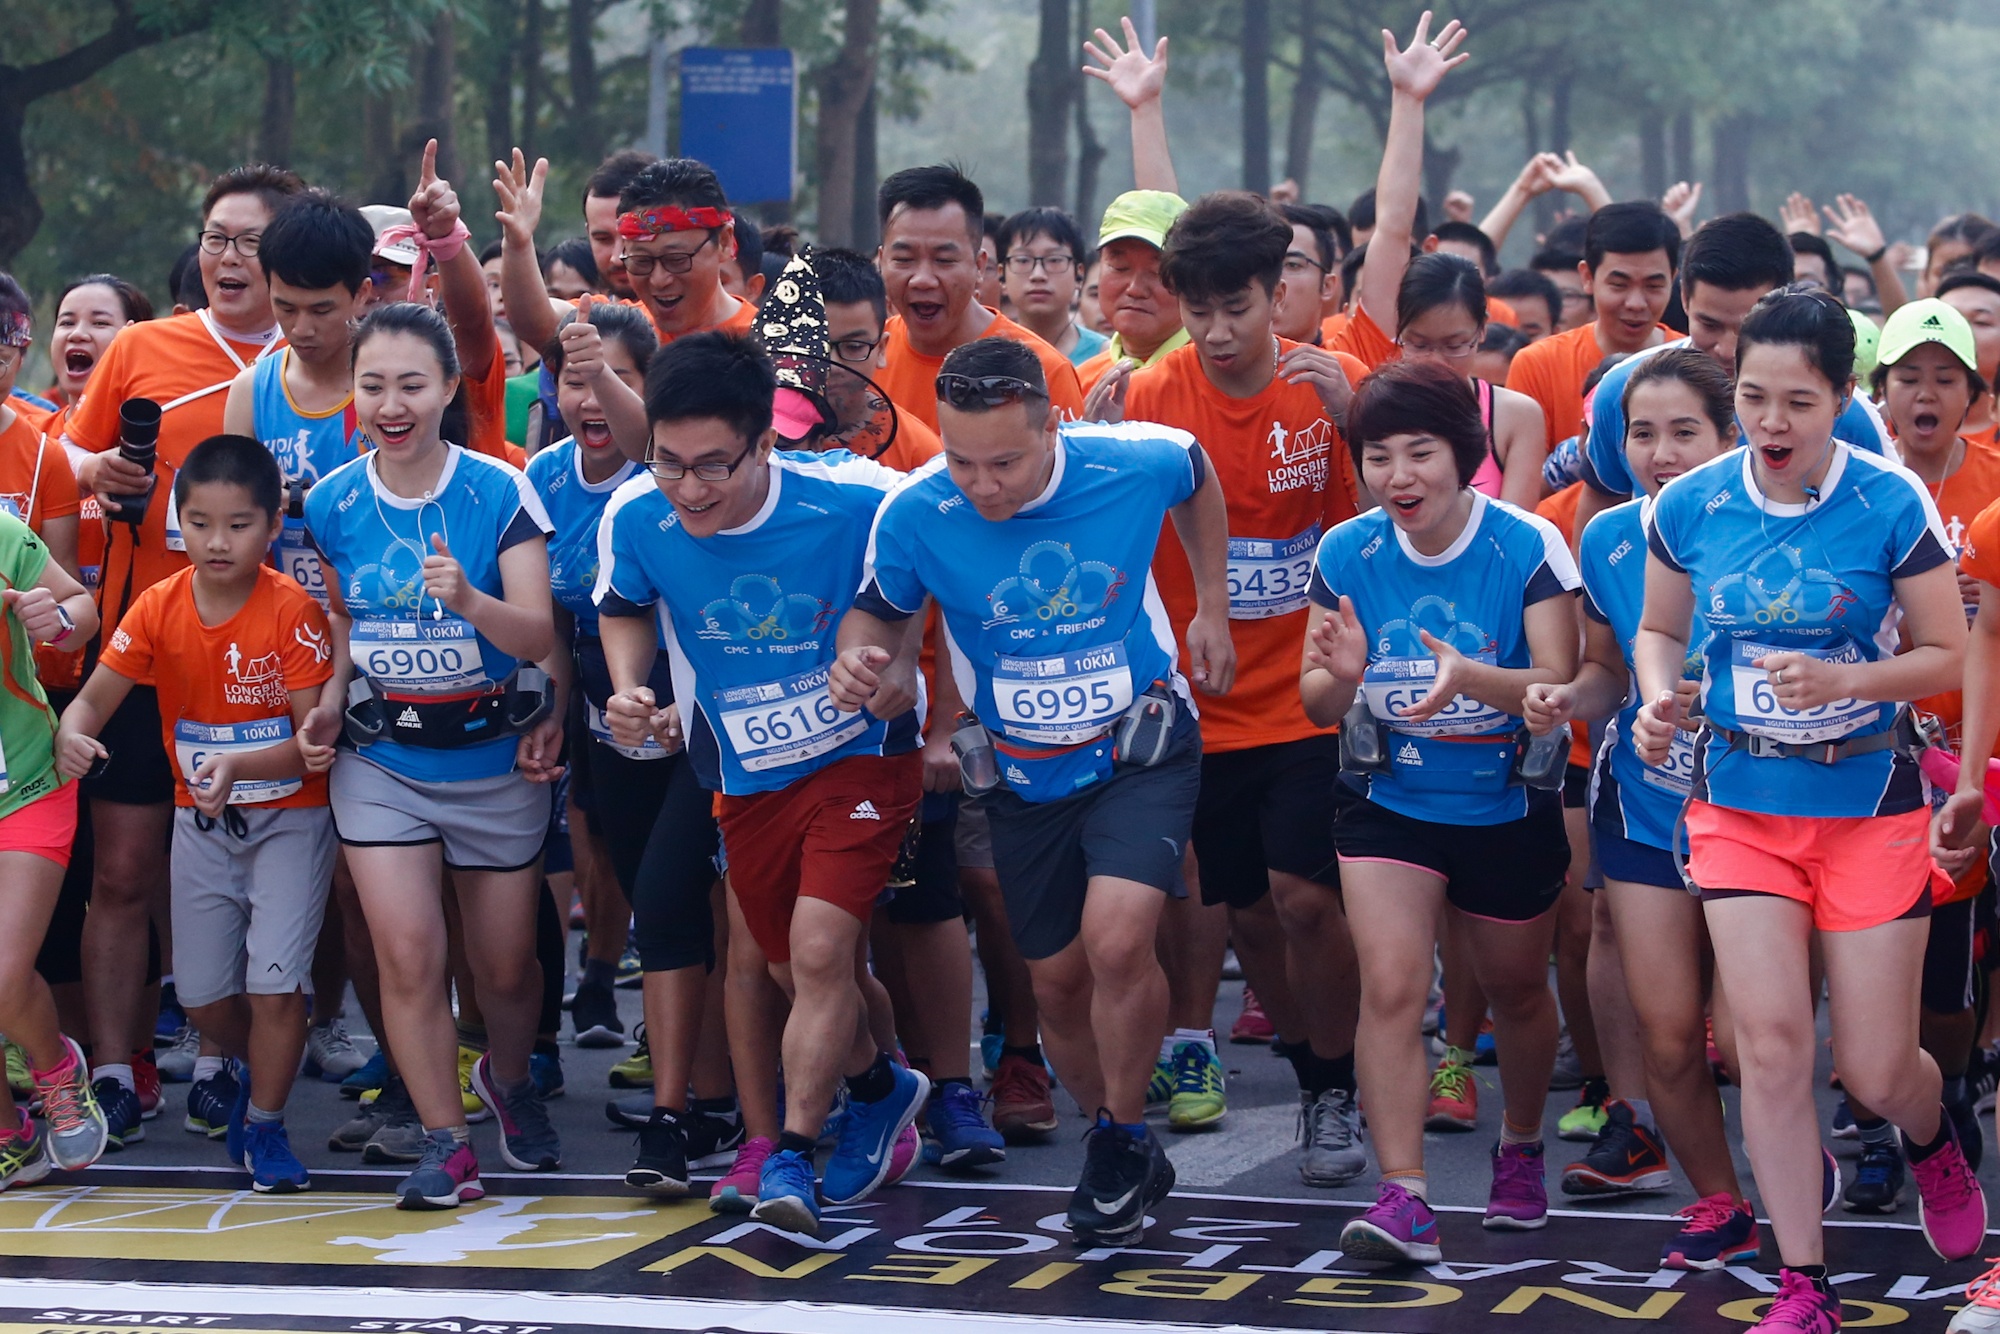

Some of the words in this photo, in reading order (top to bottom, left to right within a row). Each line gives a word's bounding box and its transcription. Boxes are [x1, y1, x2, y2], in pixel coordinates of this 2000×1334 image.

[1267, 457, 1329, 483] LONGBIE
[1269, 471, 1329, 493] MARATHO
[338, 488, 359, 512] MUDE
[1705, 489, 1731, 516] MUDE
[1282, 534, 1315, 556] 10KM
[1361, 536, 1383, 559] MUDE
[1608, 539, 1633, 566] MUDE
[425, 626, 463, 639] 10KM
[1010, 629, 1035, 639] CMC
[1056, 616, 1106, 635] FRIENDS
[724, 646, 750, 654] CMC
[769, 641, 819, 654] FRIENDS
[369, 648, 462, 675] 6900
[1002, 659, 1036, 667] LONGBIEN
[1074, 652, 1116, 672] 10KM
[723, 687, 757, 699] LONGBIEN
[790, 671, 829, 694] 10KM
[268, 696, 287, 708] 201
[1013, 681, 1114, 720] 6995
[744, 695, 840, 745] 6616
[1072, 721, 1092, 730] QUAN
[242, 725, 280, 740] 10KM
[21, 777, 46, 795] MUDE
[850, 812, 880, 820] adidas
[33, 1311, 232, 1325] START
[350, 1321, 553, 1334] START
